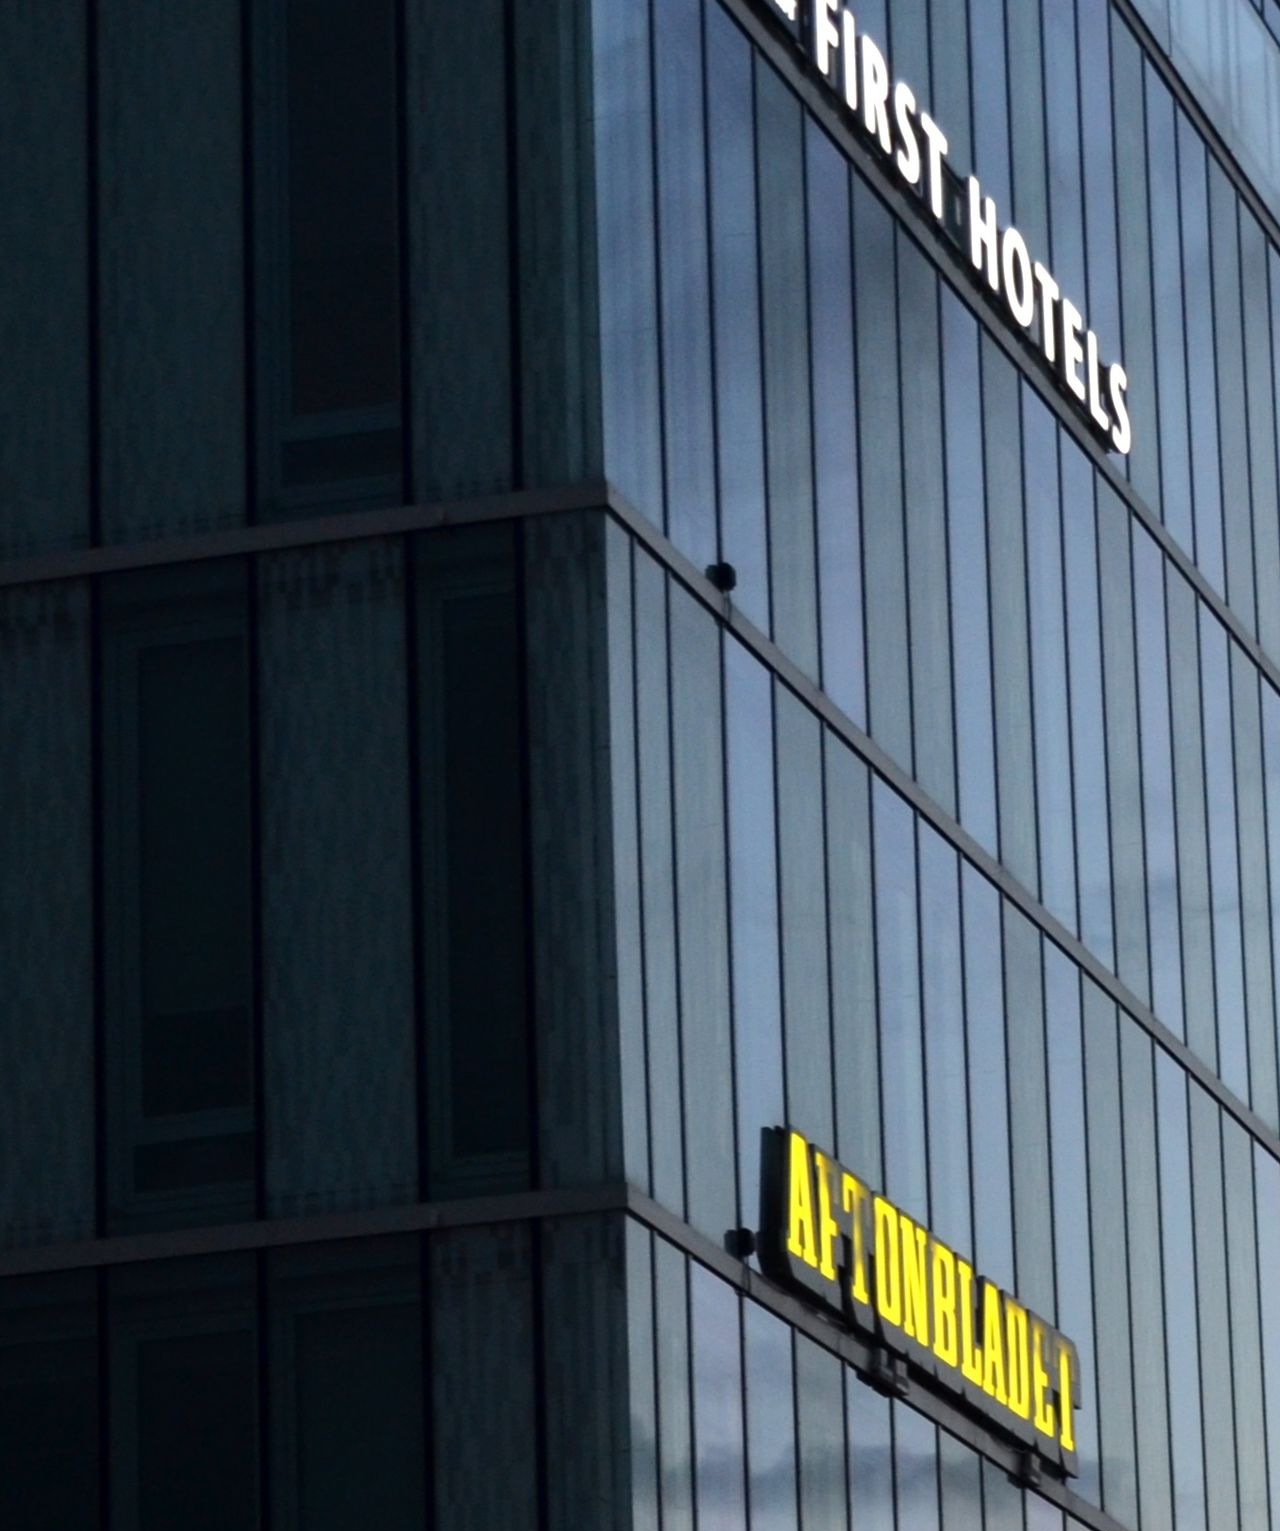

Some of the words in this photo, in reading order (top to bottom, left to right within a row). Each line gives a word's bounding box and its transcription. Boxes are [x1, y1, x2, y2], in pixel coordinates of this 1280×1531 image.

[813, 0, 948, 219] FIRST
[969, 175, 1131, 454] HOTELS
[787, 1132, 1076, 1452] AFTONBLADET
